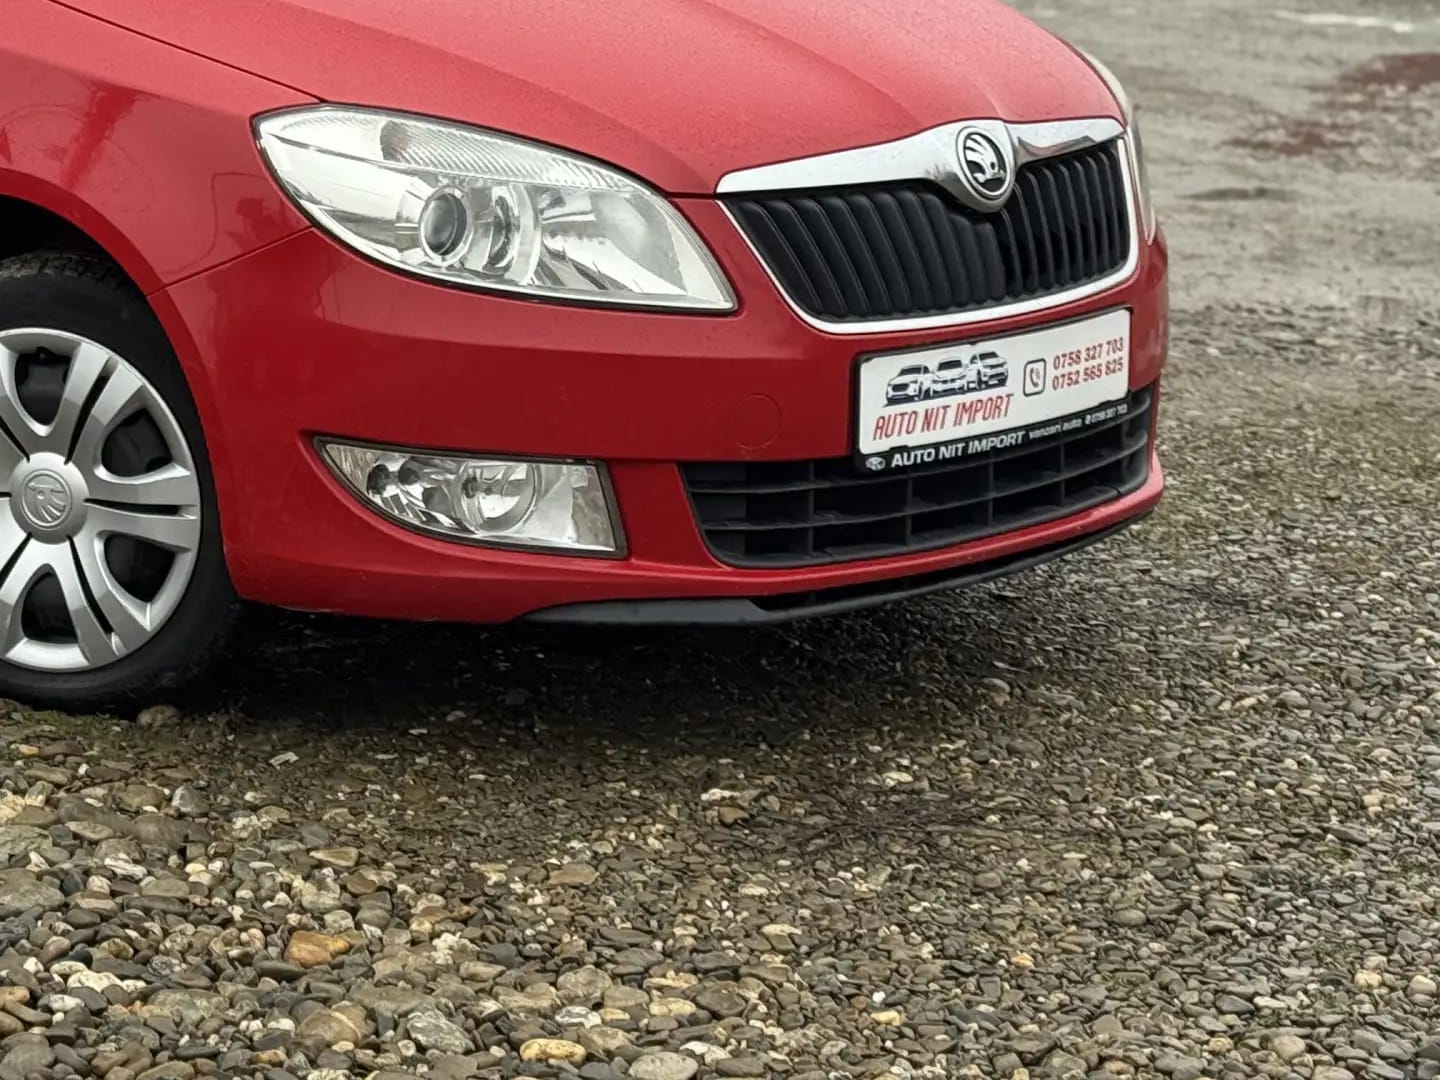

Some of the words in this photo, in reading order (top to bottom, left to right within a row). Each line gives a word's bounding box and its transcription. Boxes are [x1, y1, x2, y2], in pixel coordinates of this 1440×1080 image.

[1053, 349, 1082, 371] 0758
[1084, 343, 1103, 362] 327
[1105, 336, 1124, 356] 703
[1052, 370, 1081, 391] 0752
[873, 411, 919, 441] AUTO
[922, 405, 951, 433] NIT
[953, 393, 1014, 427] IMPORT
[890, 447, 935, 468] AUTO
[938, 442, 966, 460] NIT
[968, 431, 1026, 455] IMPORT
